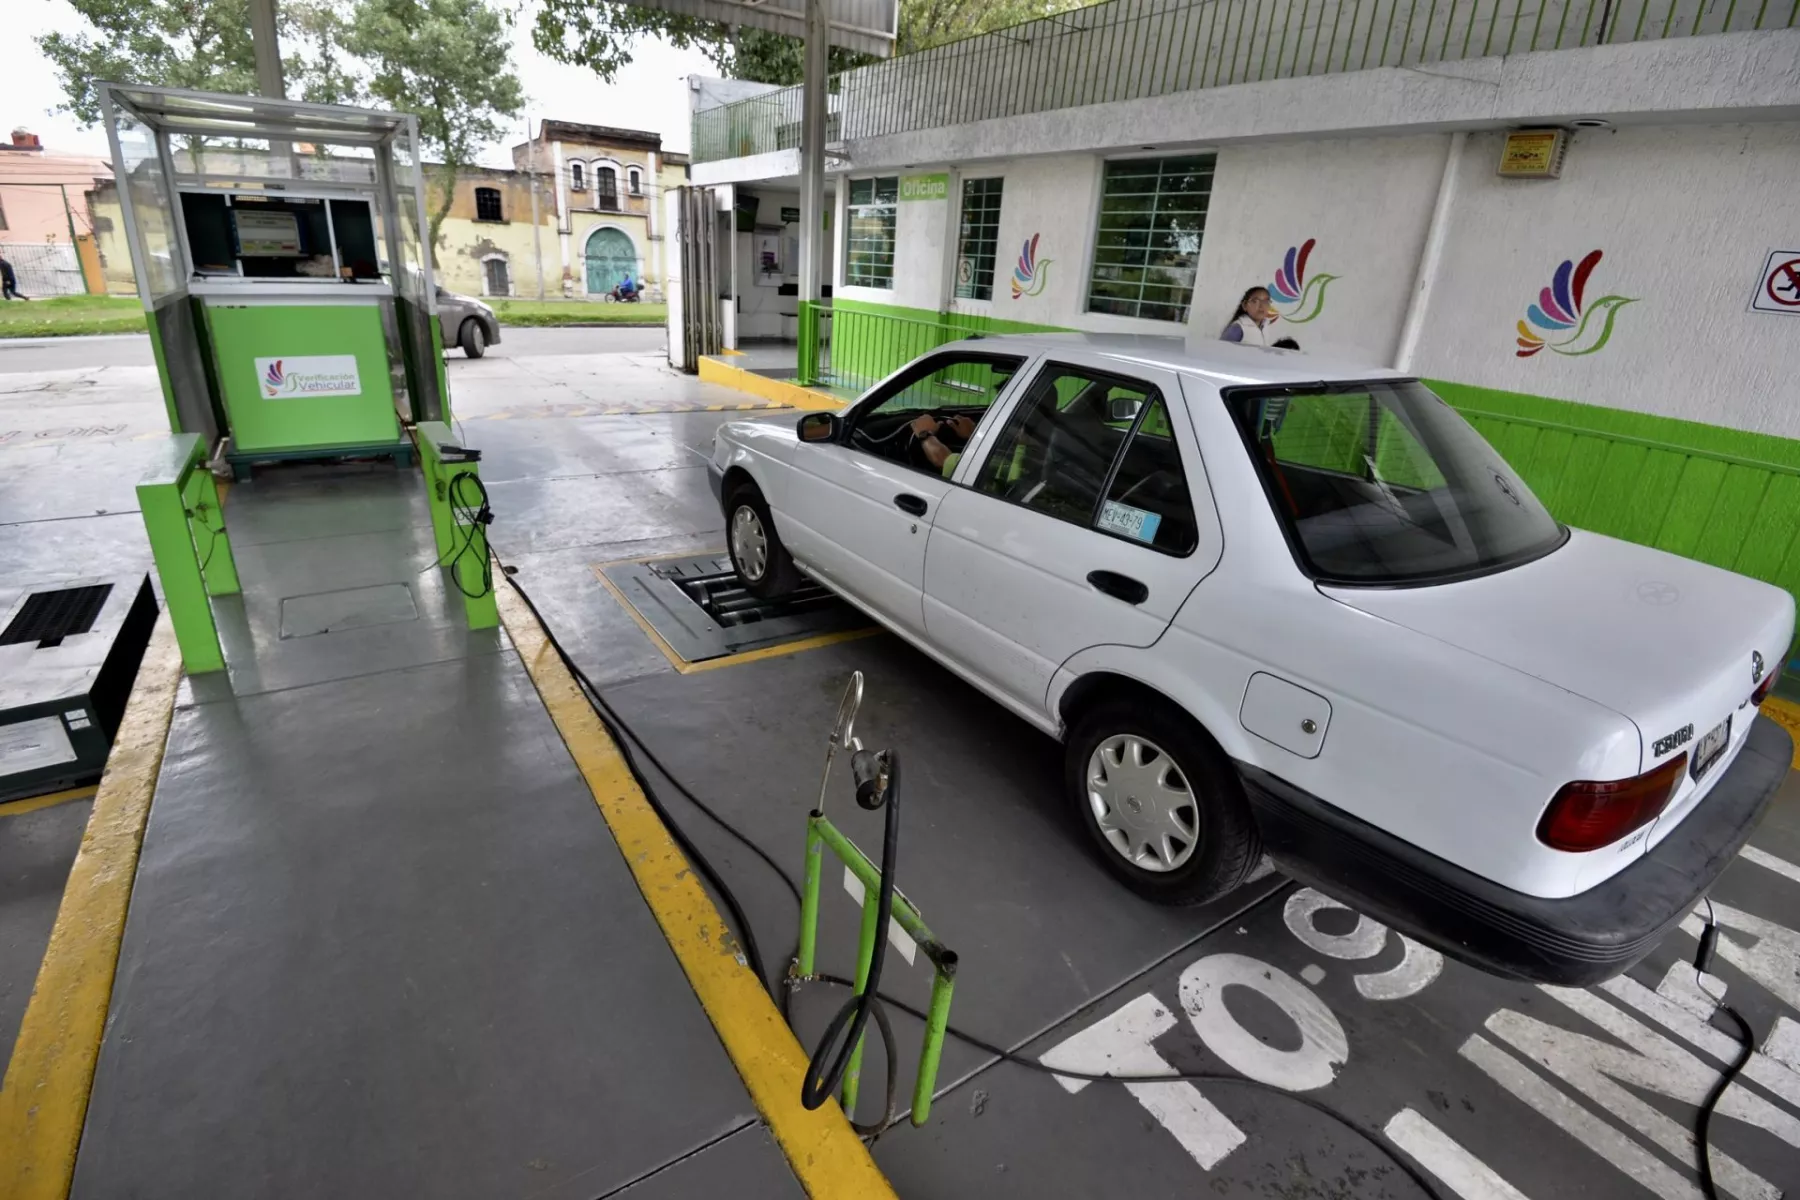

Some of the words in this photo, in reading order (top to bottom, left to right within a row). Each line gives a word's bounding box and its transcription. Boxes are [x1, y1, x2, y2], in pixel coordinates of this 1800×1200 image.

[903, 178, 945, 197] Oficina
[297, 372, 355, 382] Verificación
[299, 380, 356, 390] Vehicular
